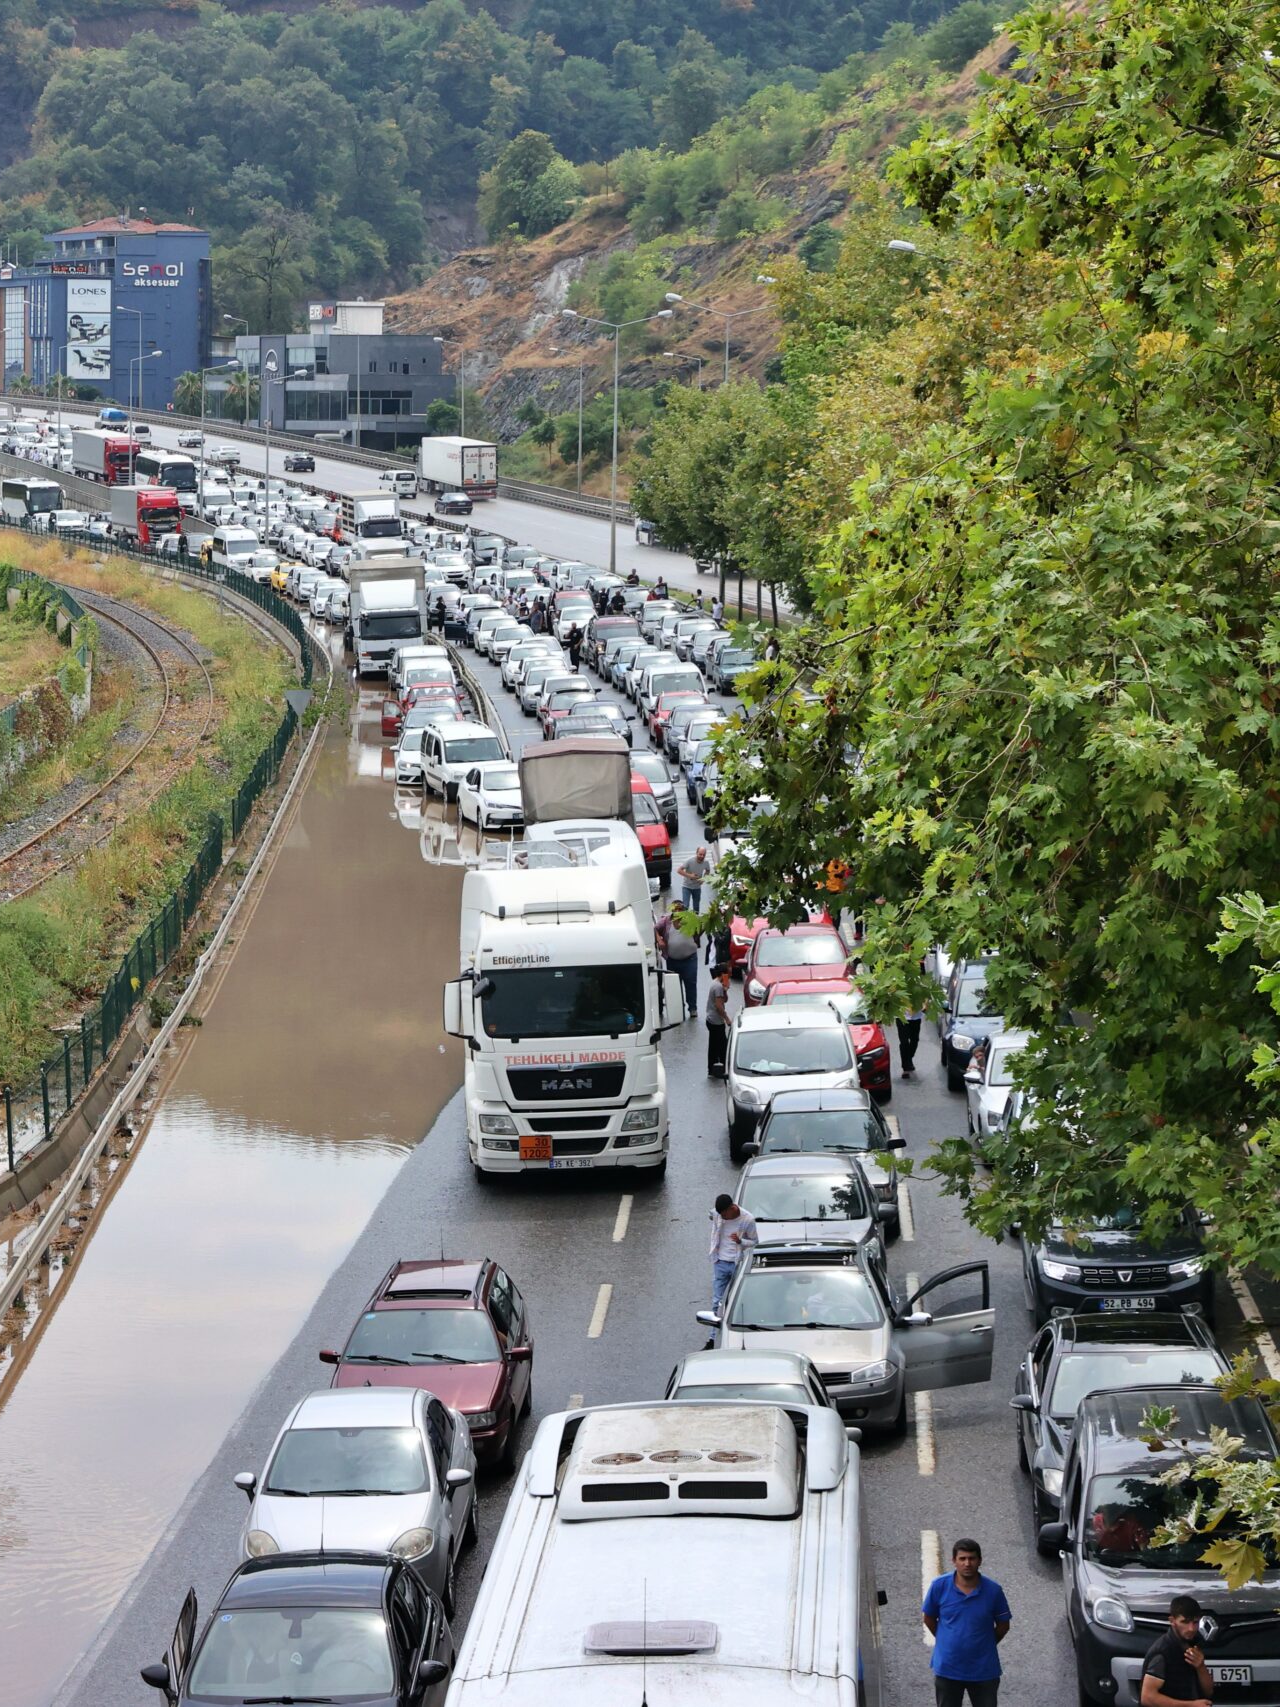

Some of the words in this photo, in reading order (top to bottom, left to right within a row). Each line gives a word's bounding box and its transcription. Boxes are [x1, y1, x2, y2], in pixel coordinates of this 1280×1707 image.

[134, 278, 179, 287] aksesuar
[492, 954, 550, 965] EfficientLine
[504, 1051, 575, 1065] TEHLİKELİ
[579, 1051, 626, 1063] MADDE
[541, 1079, 592, 1090] MAN
[535, 1138, 548, 1147] 30
[523, 1149, 548, 1158] 1202
[554, 1160, 562, 1168] 35
[578, 1159, 591, 1167] 392
[1105, 1300, 1115, 1308] 52
[1137, 1299, 1154, 1307] 494
[1220, 1668, 1248, 1681] 6751
